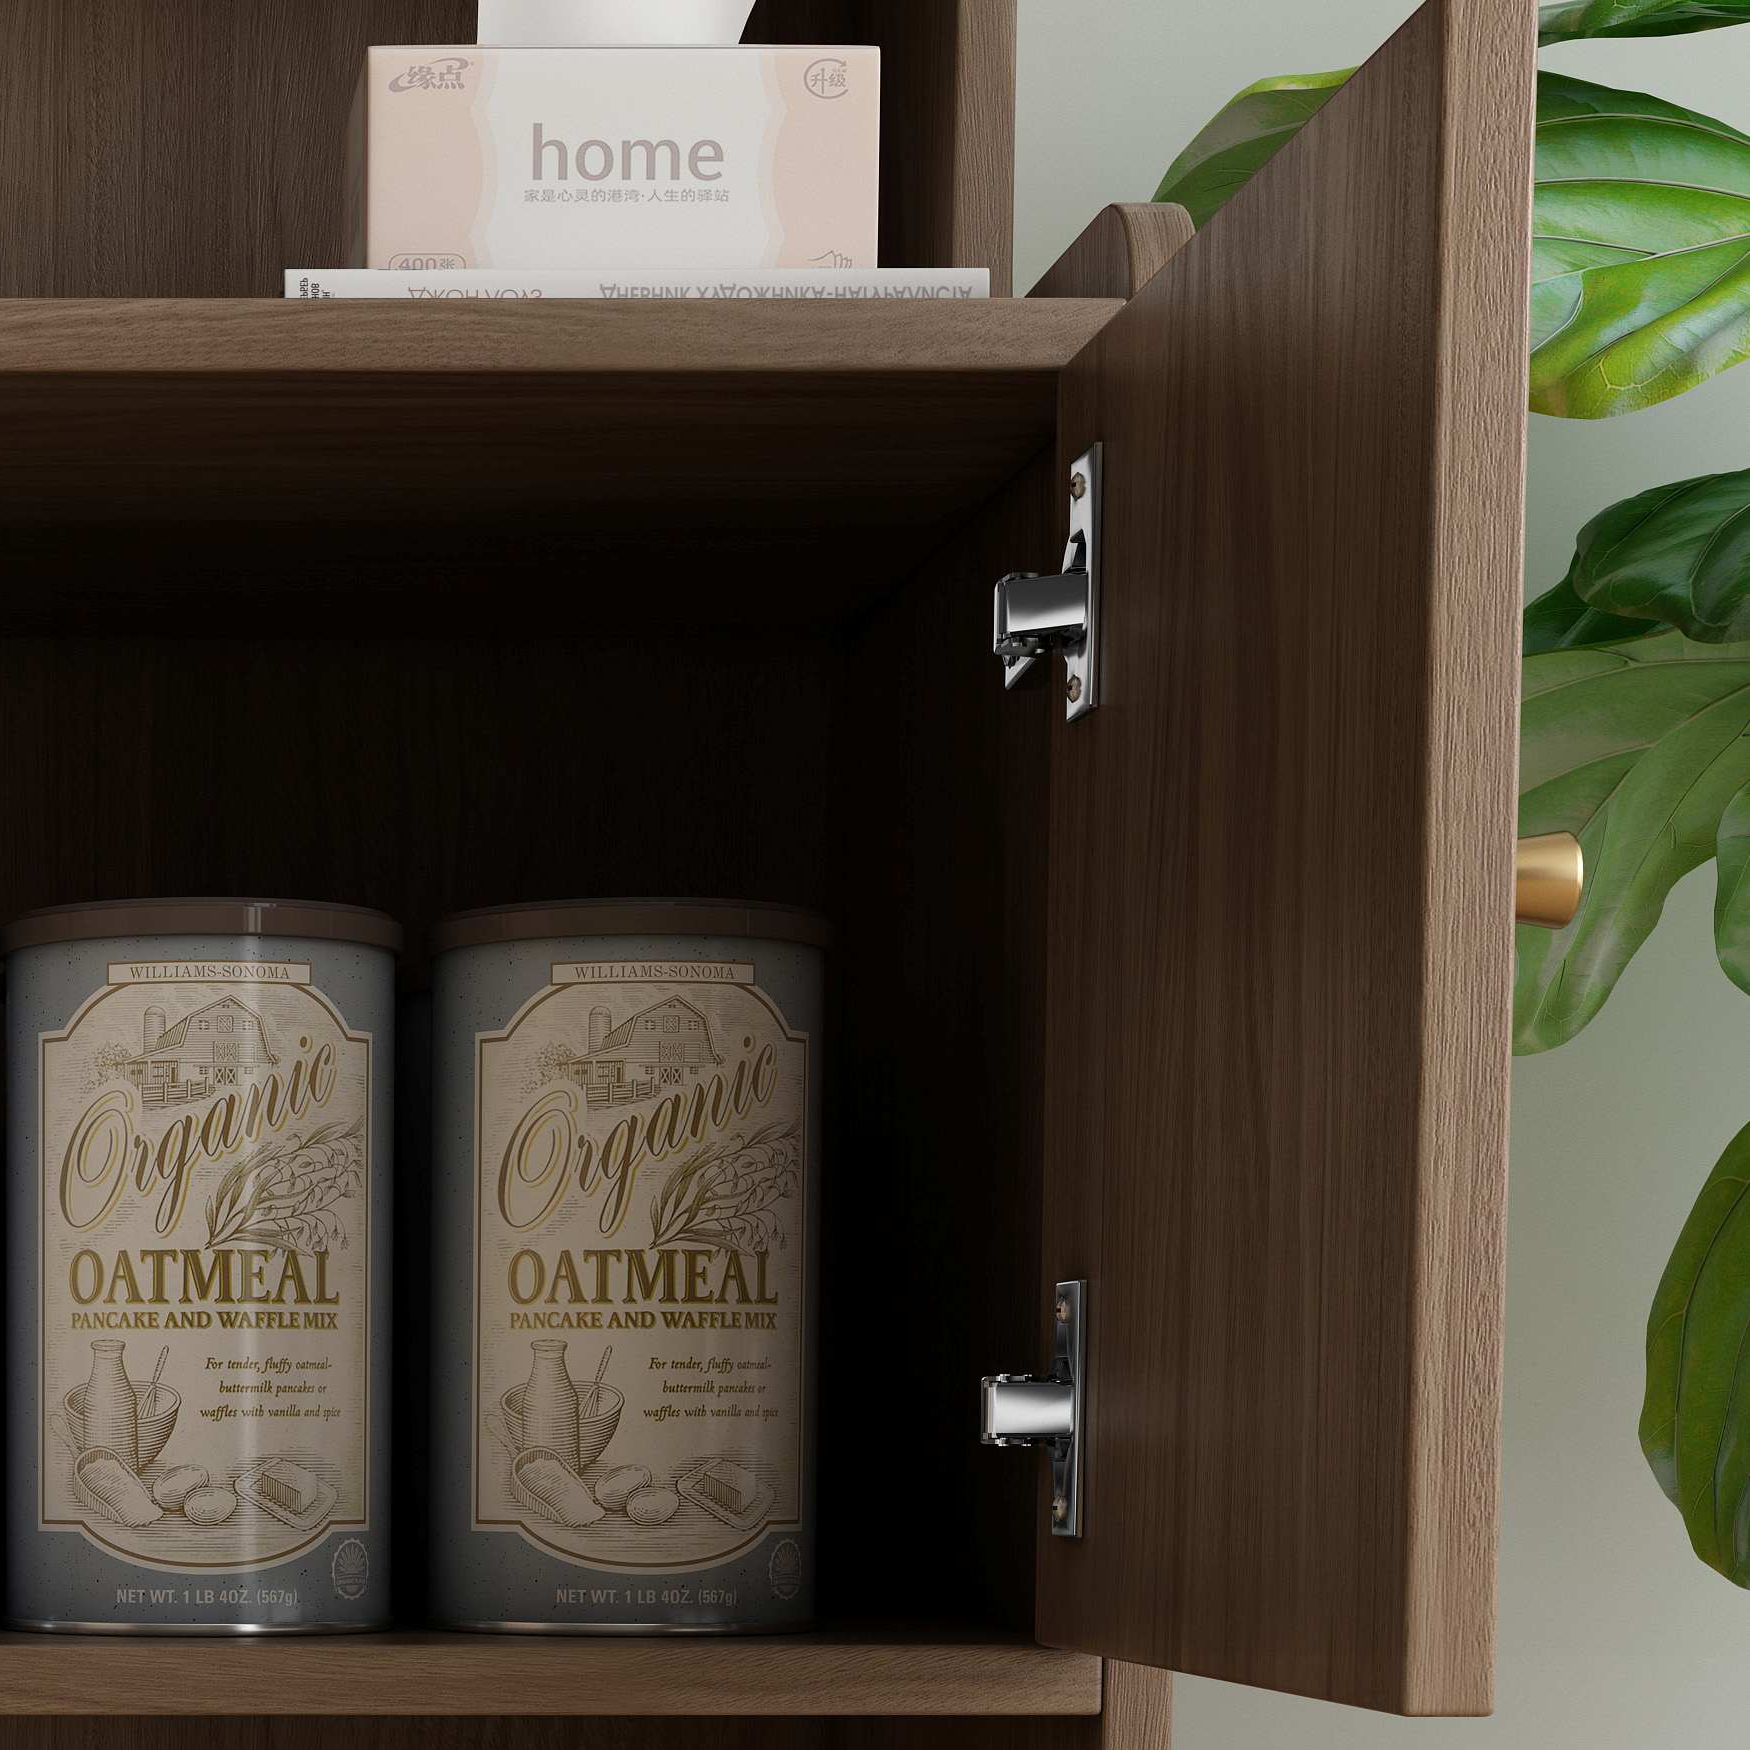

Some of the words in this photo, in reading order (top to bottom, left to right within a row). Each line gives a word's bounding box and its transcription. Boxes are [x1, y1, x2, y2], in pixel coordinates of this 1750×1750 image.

[532, 122, 725, 182] home
[129, 965, 291, 981] WILLIAMS-SONOMA
[574, 965, 736, 981] WILLIAMS-SONOMA
[59, 1036, 339, 1239] Organic
[498, 1036, 778, 1239] Organic
[68, 1247, 341, 1306] OATMEAL
[507, 1247, 780, 1306] OATMEAL
[71, 1310, 160, 1331] PANCAKE
[163, 1310, 212, 1331] AND
[216, 1310, 300, 1331] WAFFLE
[303, 1310, 339, 1331] MIX
[510, 1310, 604, 1331] PANCAKE
[607, 1310, 657, 1331] AND
[661, 1310, 742, 1331] WAFFLE
[745, 1310, 778, 1331] MIX
[204, 1356, 224, 1371] For
[227, 1356, 261, 1374] tender,
[262, 1356, 293, 1375] fluffy
[295, 1356, 333, 1371] oatmeal-
[647, 1356, 668, 1371] For
[670, 1356, 704, 1374] tender,
[705, 1356, 735, 1375] fluffy
[218, 1379, 273, 1395] buttermilk
[275, 1380, 315, 1398] pancakes
[317, 1384, 328, 1395] or
[662, 1379, 715, 1395] buttermilk
[717, 1380, 755, 1398] pancakes
[757, 1384, 766, 1395] or
[199, 1403, 238, 1422] waffles
[241, 1403, 265, 1418] with
[267, 1403, 301, 1418] vanilla
[303, 1403, 321, 1418] and
[322, 1404, 341, 1422] spice
[642, 1403, 681, 1422] waffles
[683, 1403, 707, 1418] with
[710, 1403, 742, 1418] vanilla
[744, 1403, 761, 1418] and
[761, 1404, 779, 1422] spice
[116, 1589, 146, 1605] NET
[150, 1589, 178, 1605] WT.
[183, 1589, 190, 1605] 1
[195, 1589, 215, 1605] LB
[256, 1588, 299, 1607] (567g)
[556, 1589, 586, 1605] NET
[591, 1589, 619, 1605] WT.
[624, 1589, 632, 1605] 1
[637, 1589, 657, 1605] LB
[698, 1588, 737, 1607] (567g)
